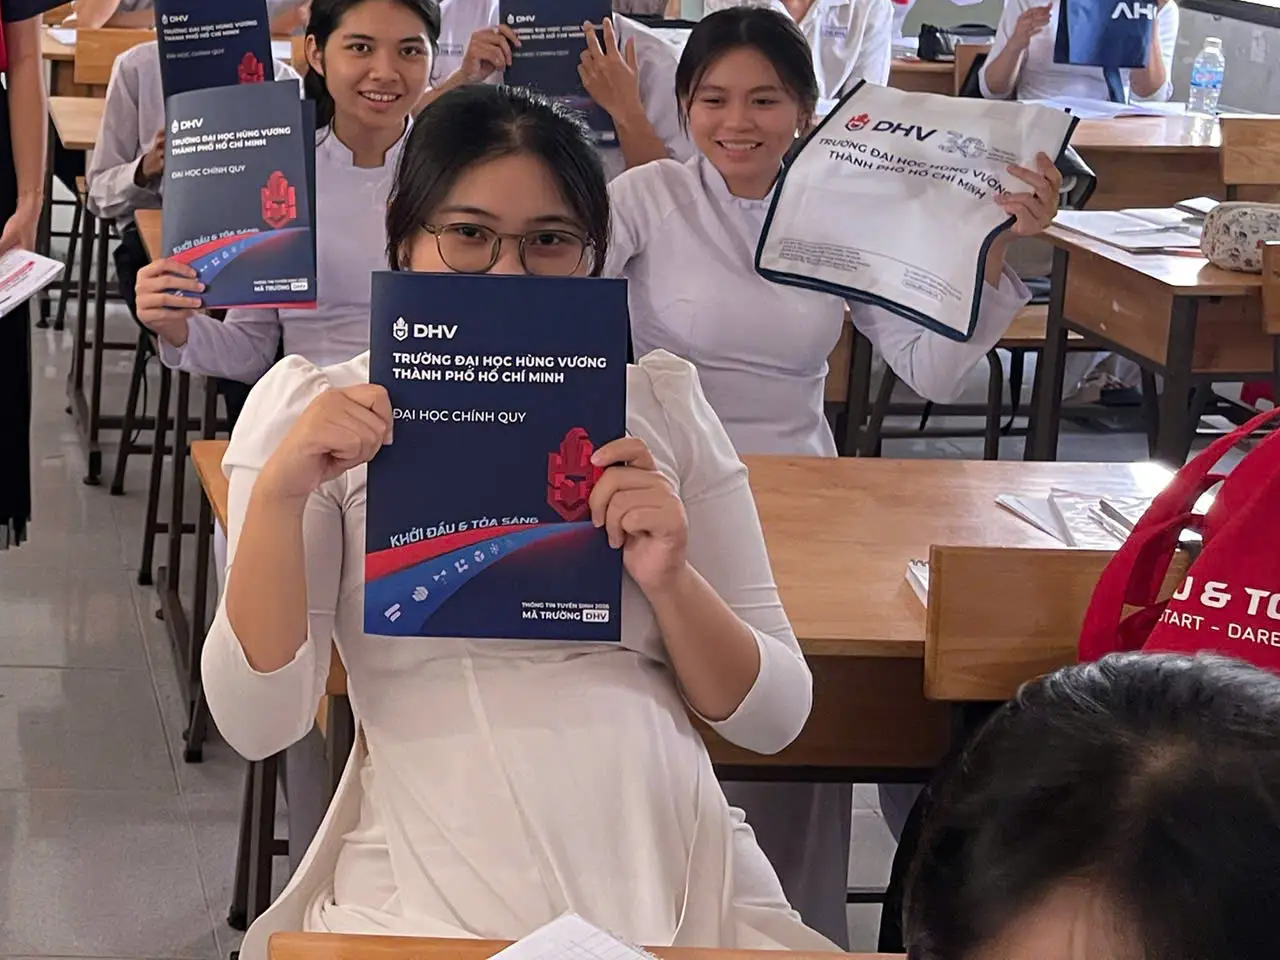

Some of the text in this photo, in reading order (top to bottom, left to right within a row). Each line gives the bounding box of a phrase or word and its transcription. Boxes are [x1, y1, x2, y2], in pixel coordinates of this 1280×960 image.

[180, 117, 204, 130] DHV
[872, 120, 938, 141] DHV
[819, 138, 868, 153] TRƯỜNG
[869, 147, 895, 163] ĐẠI
[896, 155, 927, 169] HỌC
[929, 163, 969, 175] HÙNG
[828, 149, 987, 200] THÀNH PHỐ HỒ CHÍ MINH
[413, 324, 458, 339] DHV
[392, 351, 607, 369] TRƯỜNG ĐẠI HỌC HÙNG VƯƠNG
[392, 367, 565, 384] THÀNH PHỐ HỒ CHÍ MINH
[393, 408, 527, 423] ĐẠI HỌC CHÍNH QUY
[389, 527, 424, 548] KHỞI
[425, 521, 456, 538] ĐẦU
[501, 515, 539, 526] SÁNG
[1200, 581, 1232, 608] &
[521, 600, 544, 609] THÔNG
[522, 609, 608, 621] MÃ TRƯỜNG DHV
